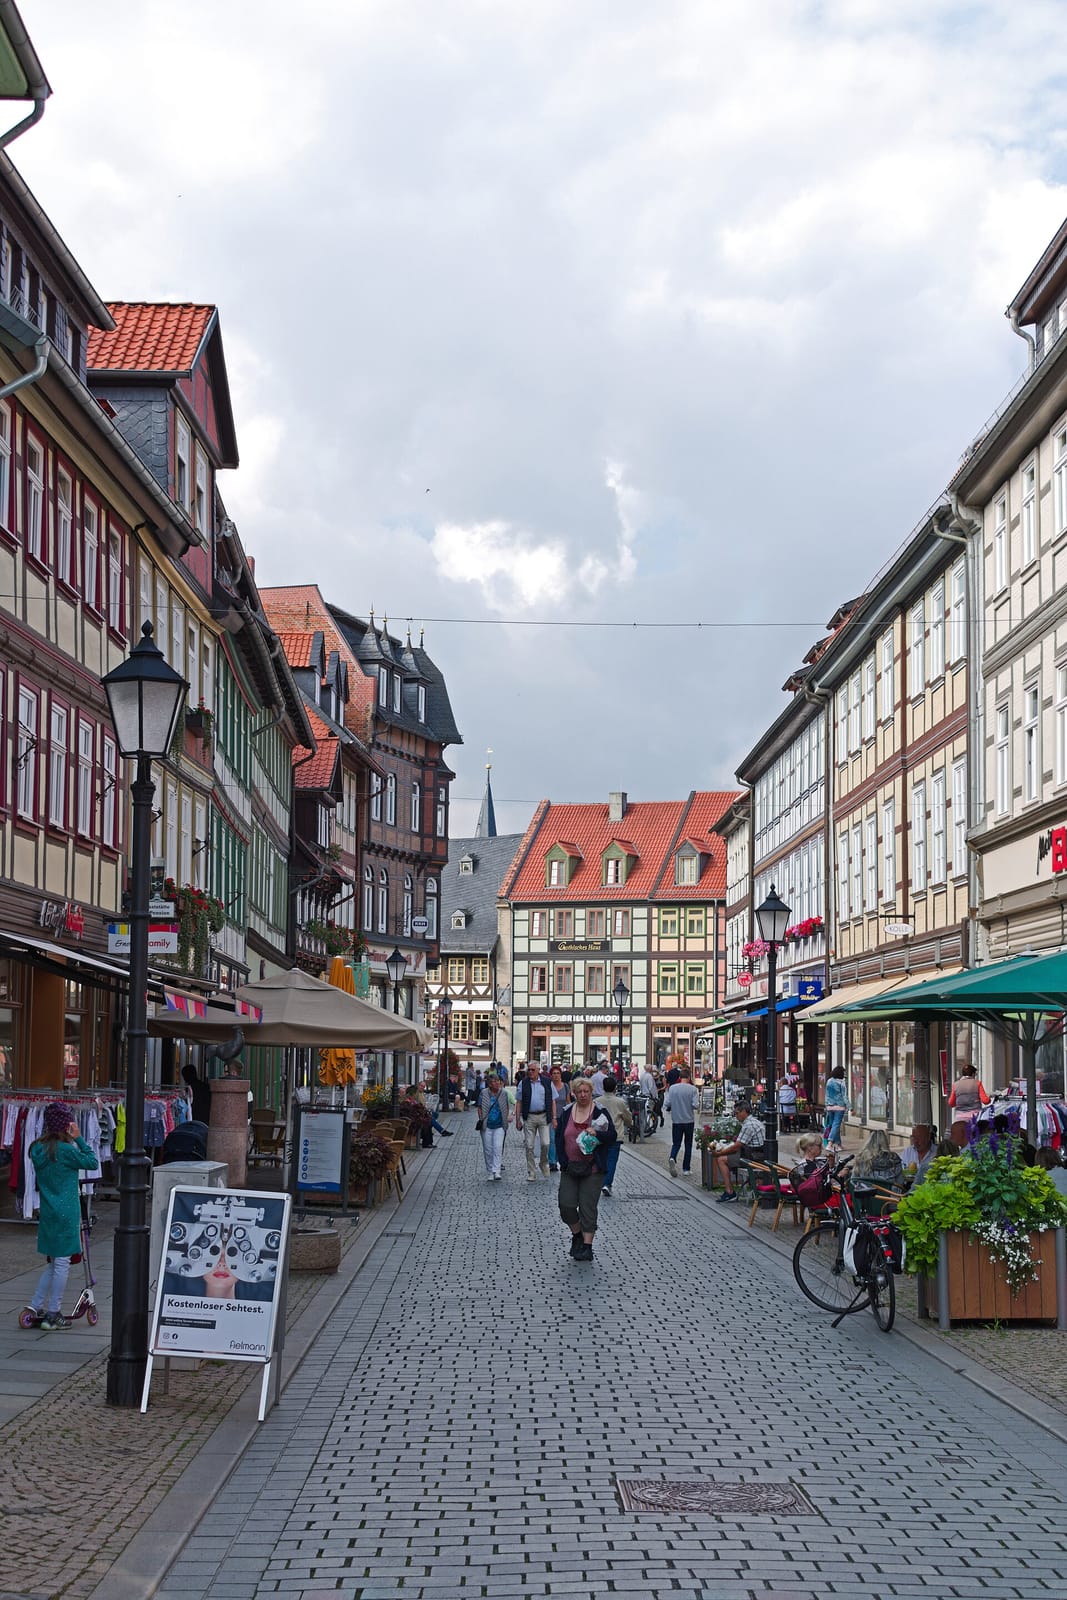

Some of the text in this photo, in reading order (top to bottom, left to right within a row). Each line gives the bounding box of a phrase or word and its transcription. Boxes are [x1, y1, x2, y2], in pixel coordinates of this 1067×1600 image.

[148, 939, 170, 949] amily
[167, 1298, 224, 1311] Kostenloser
[225, 1303, 264, 1314] Sehtest.
